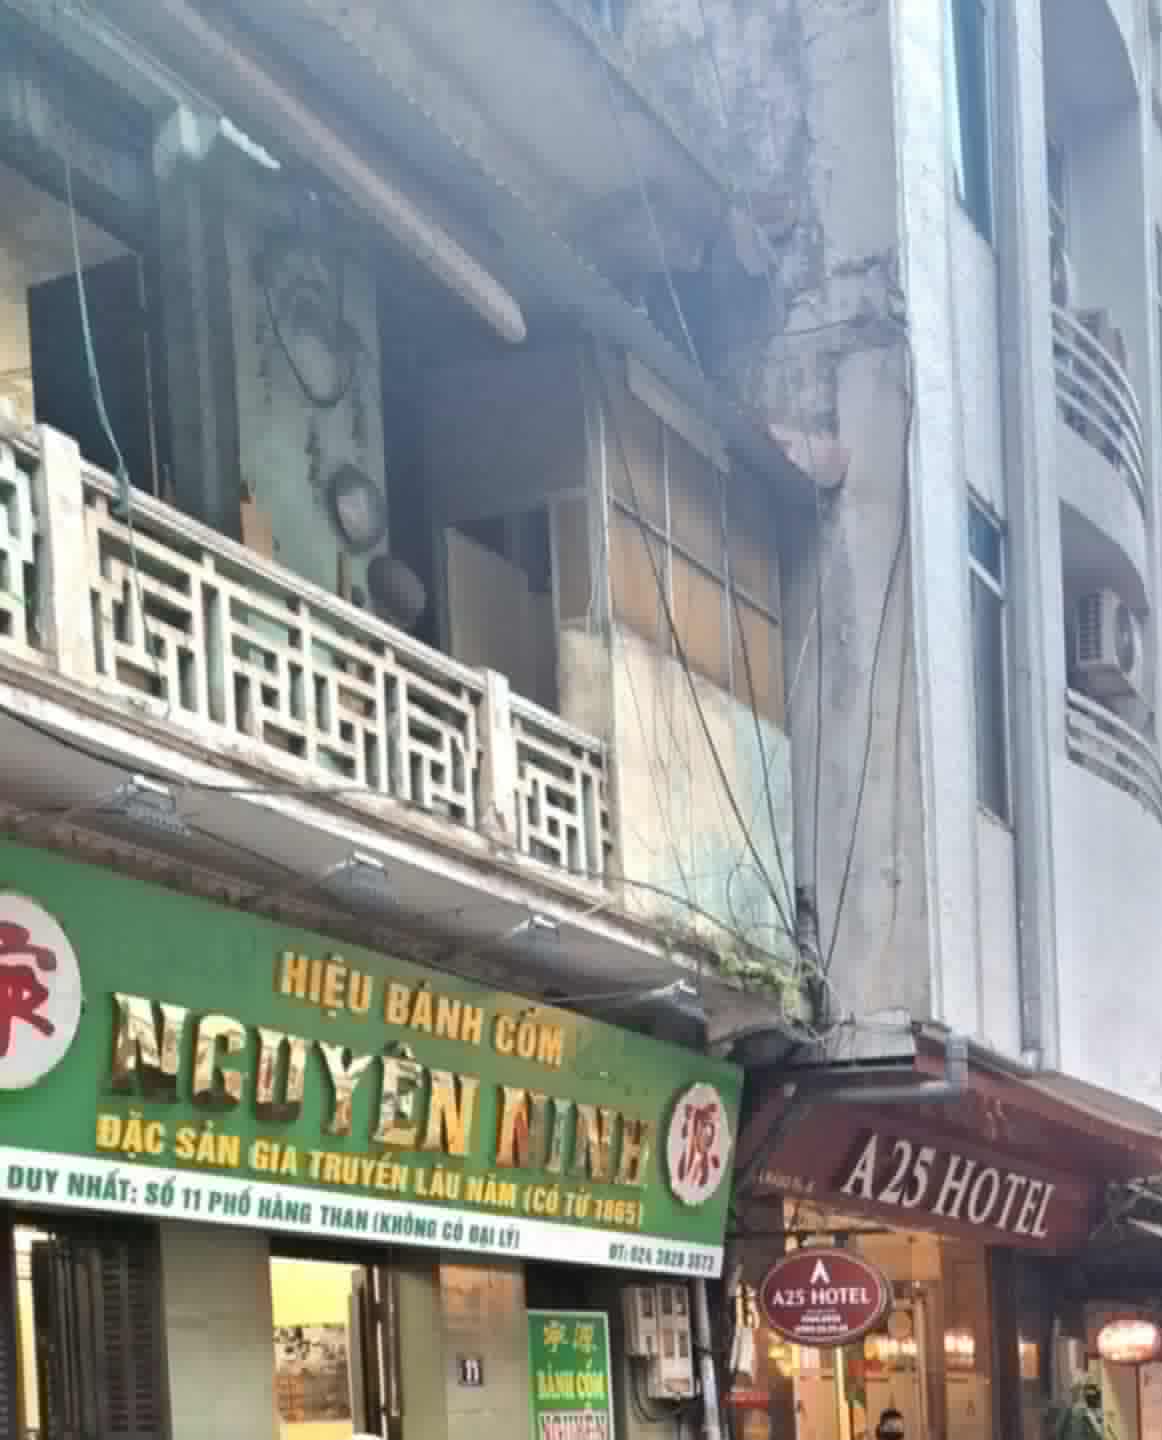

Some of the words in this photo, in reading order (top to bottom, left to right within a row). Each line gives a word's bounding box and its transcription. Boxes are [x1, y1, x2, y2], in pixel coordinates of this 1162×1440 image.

[281, 951, 372, 1018] HIỆU
[386, 979, 482, 1045] BÁNH
[495, 1007, 563, 1069] CỐM
[96, 1109, 165, 1159] ĐẶC
[175, 1120, 241, 1167] SẢN
[250, 1139, 299, 1175] GIA
[495, 1085, 649, 1185] NINH
[7, 1165, 59, 1193] DUY
[145, 1175, 177, 1208] SỐ
[183, 1188, 201, 1212] 11
[208, 1185, 253, 1217] PHỐ
[320, 1204, 369, 1231] THAN
[442, 1217, 465, 1242] CÓ
[931, 1154, 1056, 1239] HOTEL
[772, 1290, 805, 1305] A25
[811, 1288, 871, 1305] HOTEL
